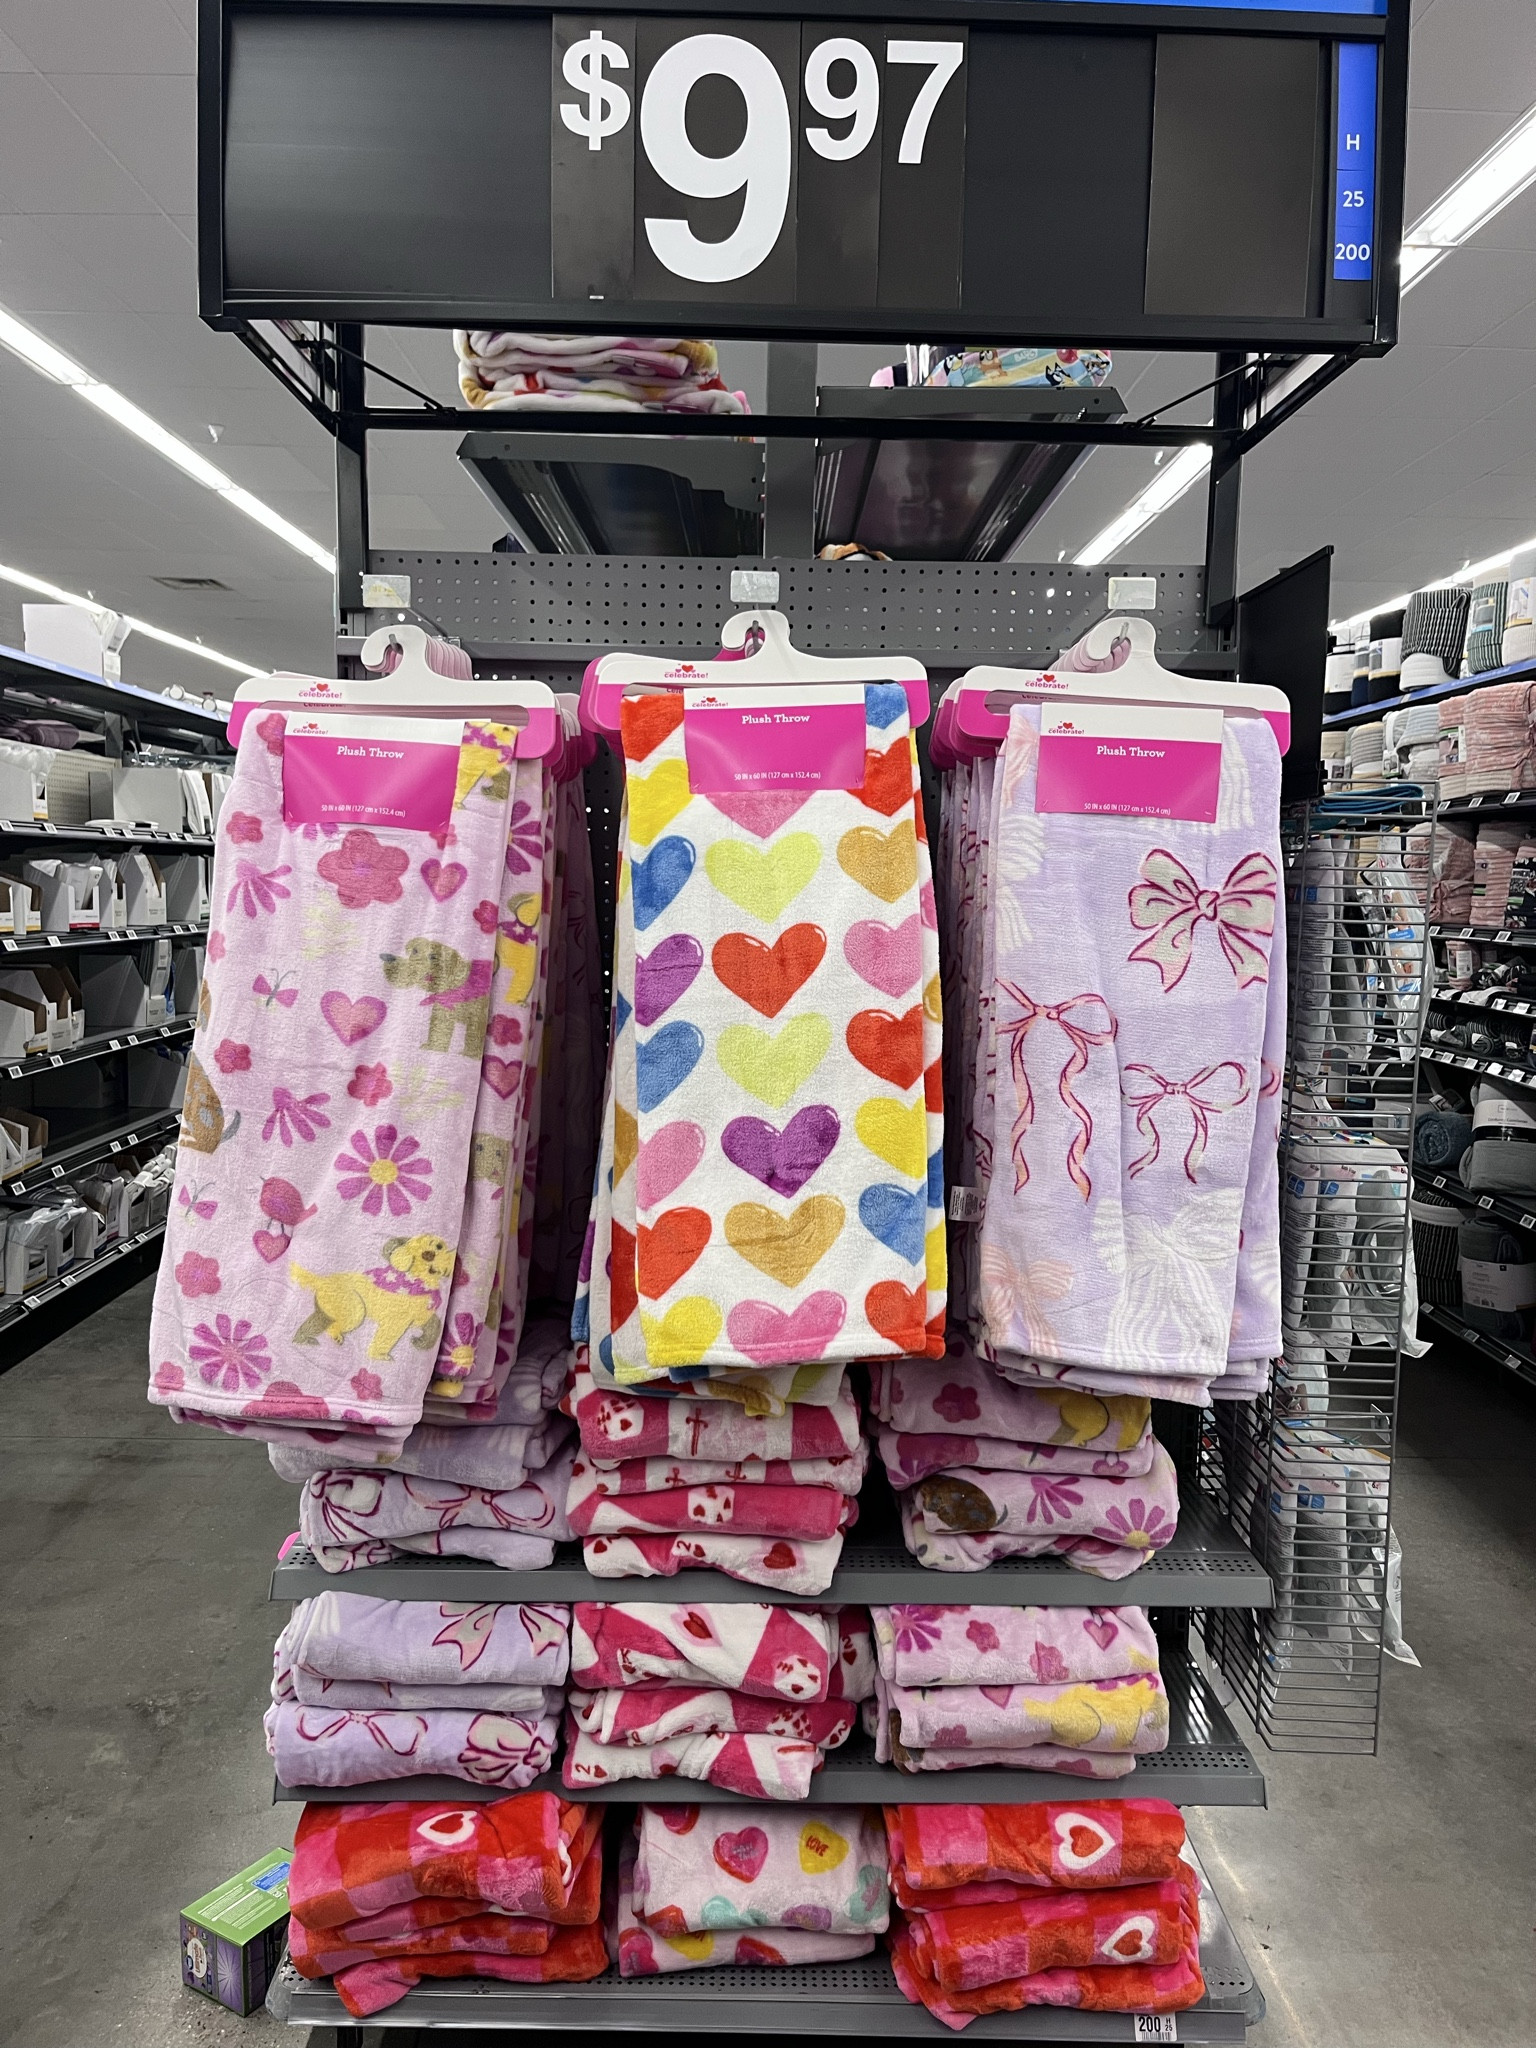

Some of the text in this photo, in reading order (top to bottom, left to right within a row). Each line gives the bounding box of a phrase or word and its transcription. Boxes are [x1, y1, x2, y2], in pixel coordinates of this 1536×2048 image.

[1346, 134, 1360, 151] H
[1343, 191, 1365, 208] 25
[1335, 243, 1370, 261] 200
[1025, 681, 1069, 690] celebrate!
[298, 690, 342, 699] celebrate!
[741, 713, 810, 724] Plush Throw
[336, 746, 404, 759] Plush Throw
[1096, 745, 1165, 758] Plush Throw
[806, 1835, 829, 1857] LOVE
[1138, 2016, 1161, 2032] 200
[1165, 2024, 1173, 2032] 25
